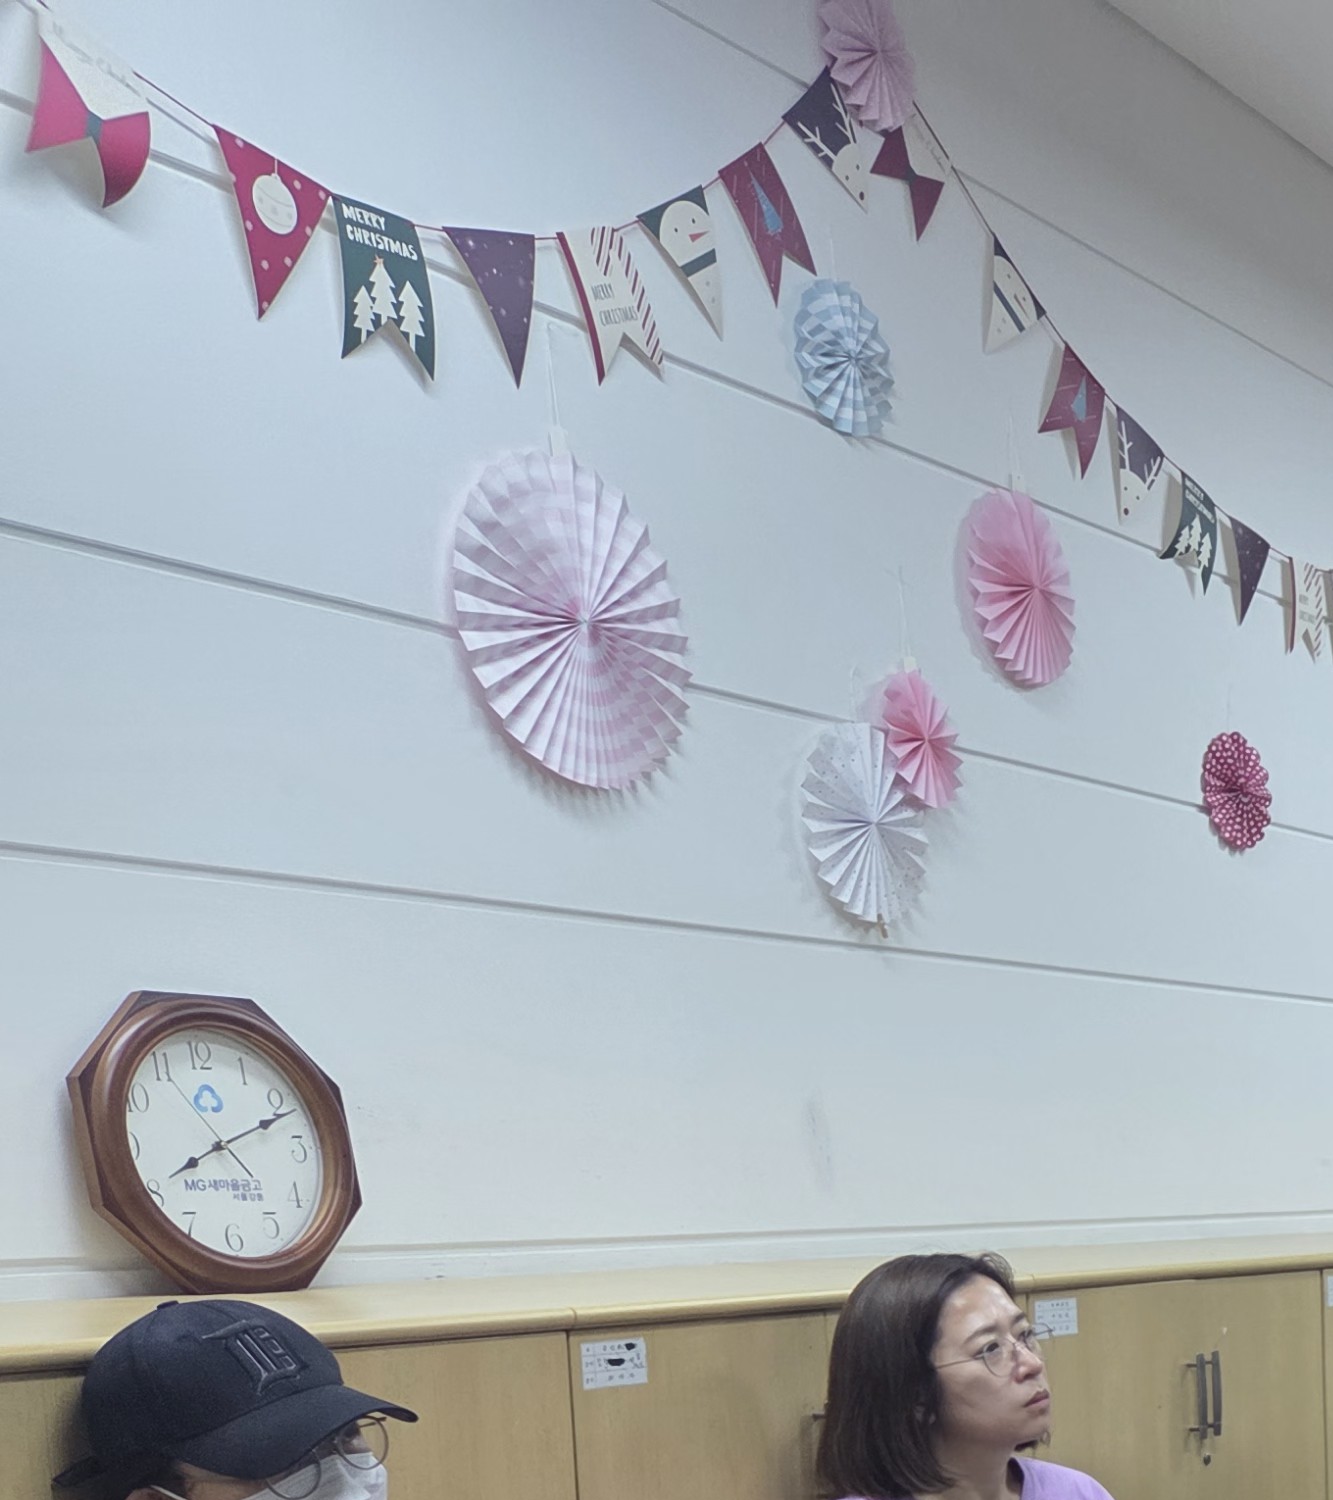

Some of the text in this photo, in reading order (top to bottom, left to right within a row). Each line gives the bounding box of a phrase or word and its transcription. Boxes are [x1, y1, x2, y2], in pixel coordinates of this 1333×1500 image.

[342, 204, 386, 230] MERRY
[346, 225, 418, 261] CHRISTMAS
[591, 284, 614, 302] MERRY
[599, 306, 638, 326] CHRISTMAS
[151, 1051, 172, 1082] 11
[188, 1040, 213, 1070] 12
[291, 1135, 307, 1163] 3
[147, 1179, 165, 1207] 8
[287, 1181, 303, 1208] 4
[225, 1223, 244, 1252] 6
[262, 1212, 280, 1238] 5
